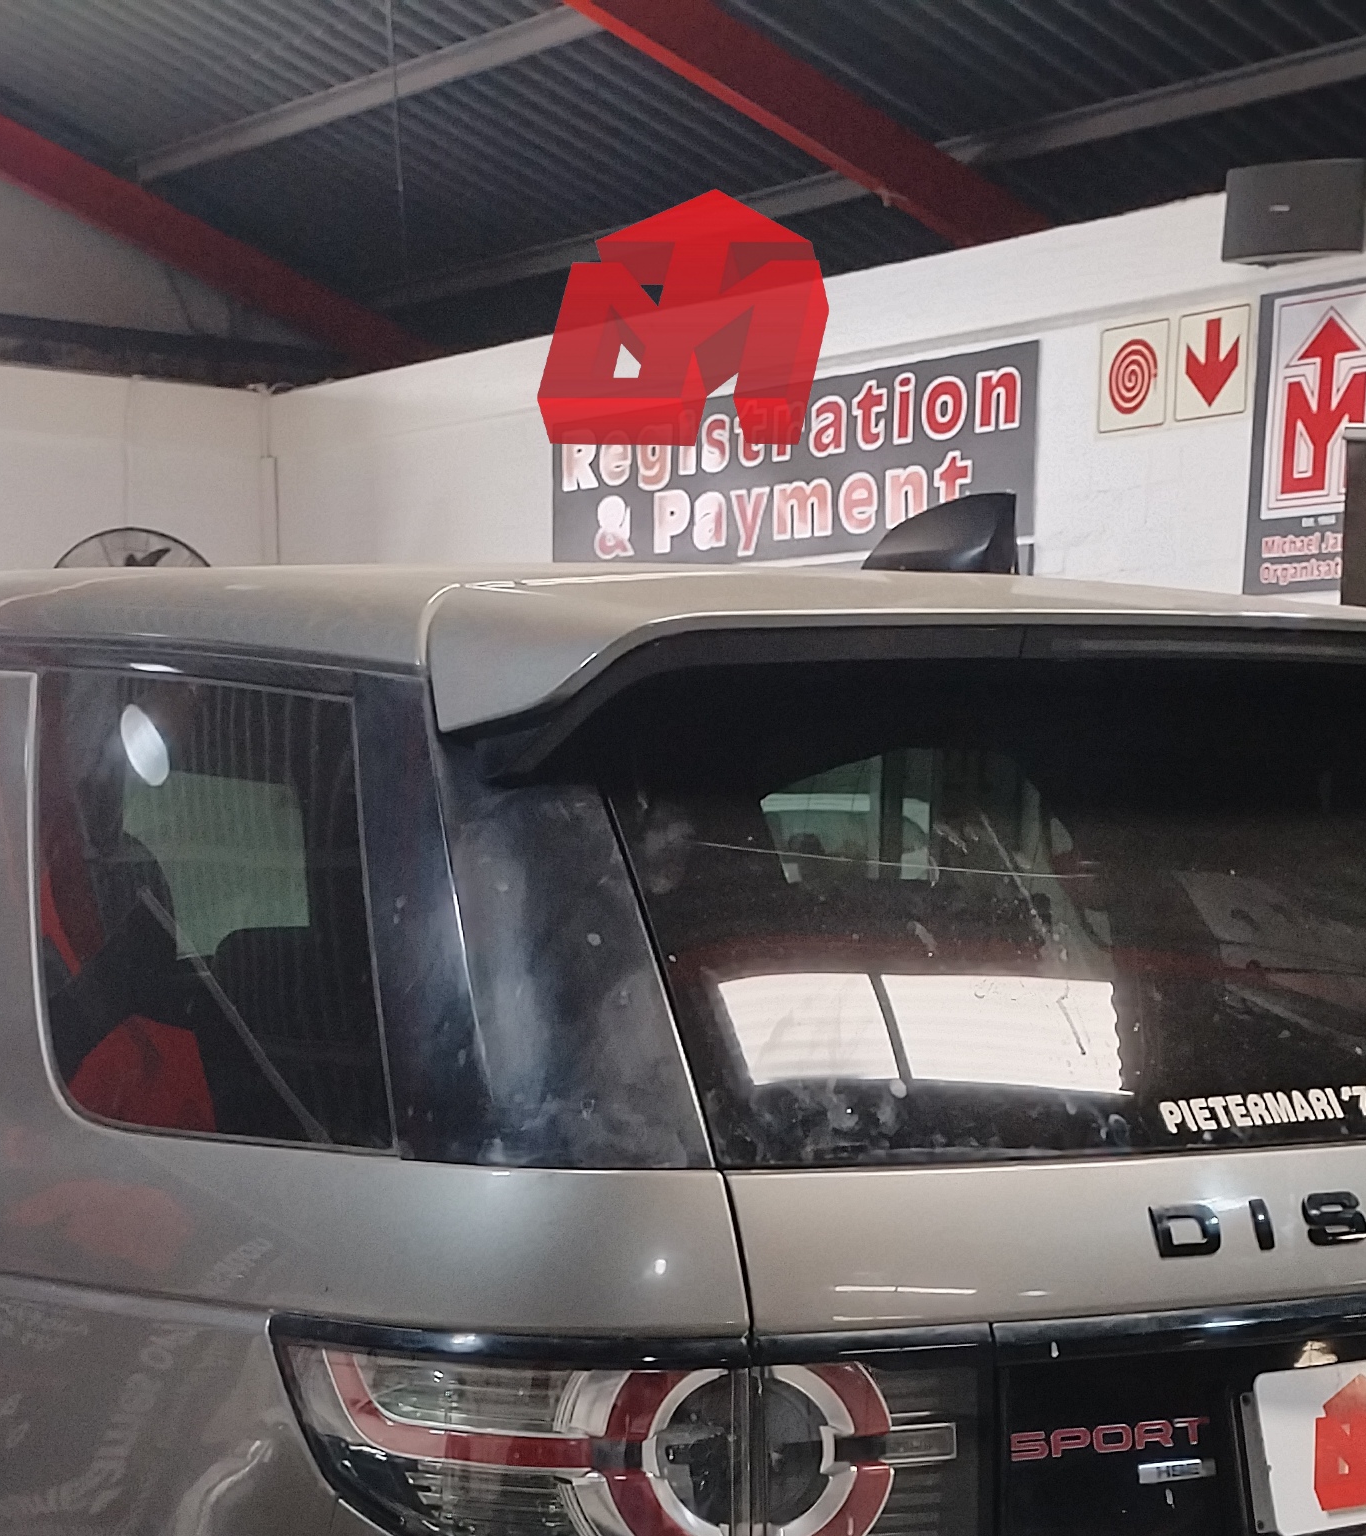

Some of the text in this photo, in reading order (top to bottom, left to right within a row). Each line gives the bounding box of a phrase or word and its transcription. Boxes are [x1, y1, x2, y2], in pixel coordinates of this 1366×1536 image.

[561, 366, 1022, 492] Registration
[594, 495, 634, 559] &
[1261, 531, 1343, 558] Michael Ja
[1010, 1417, 1210, 1462] SPORT
